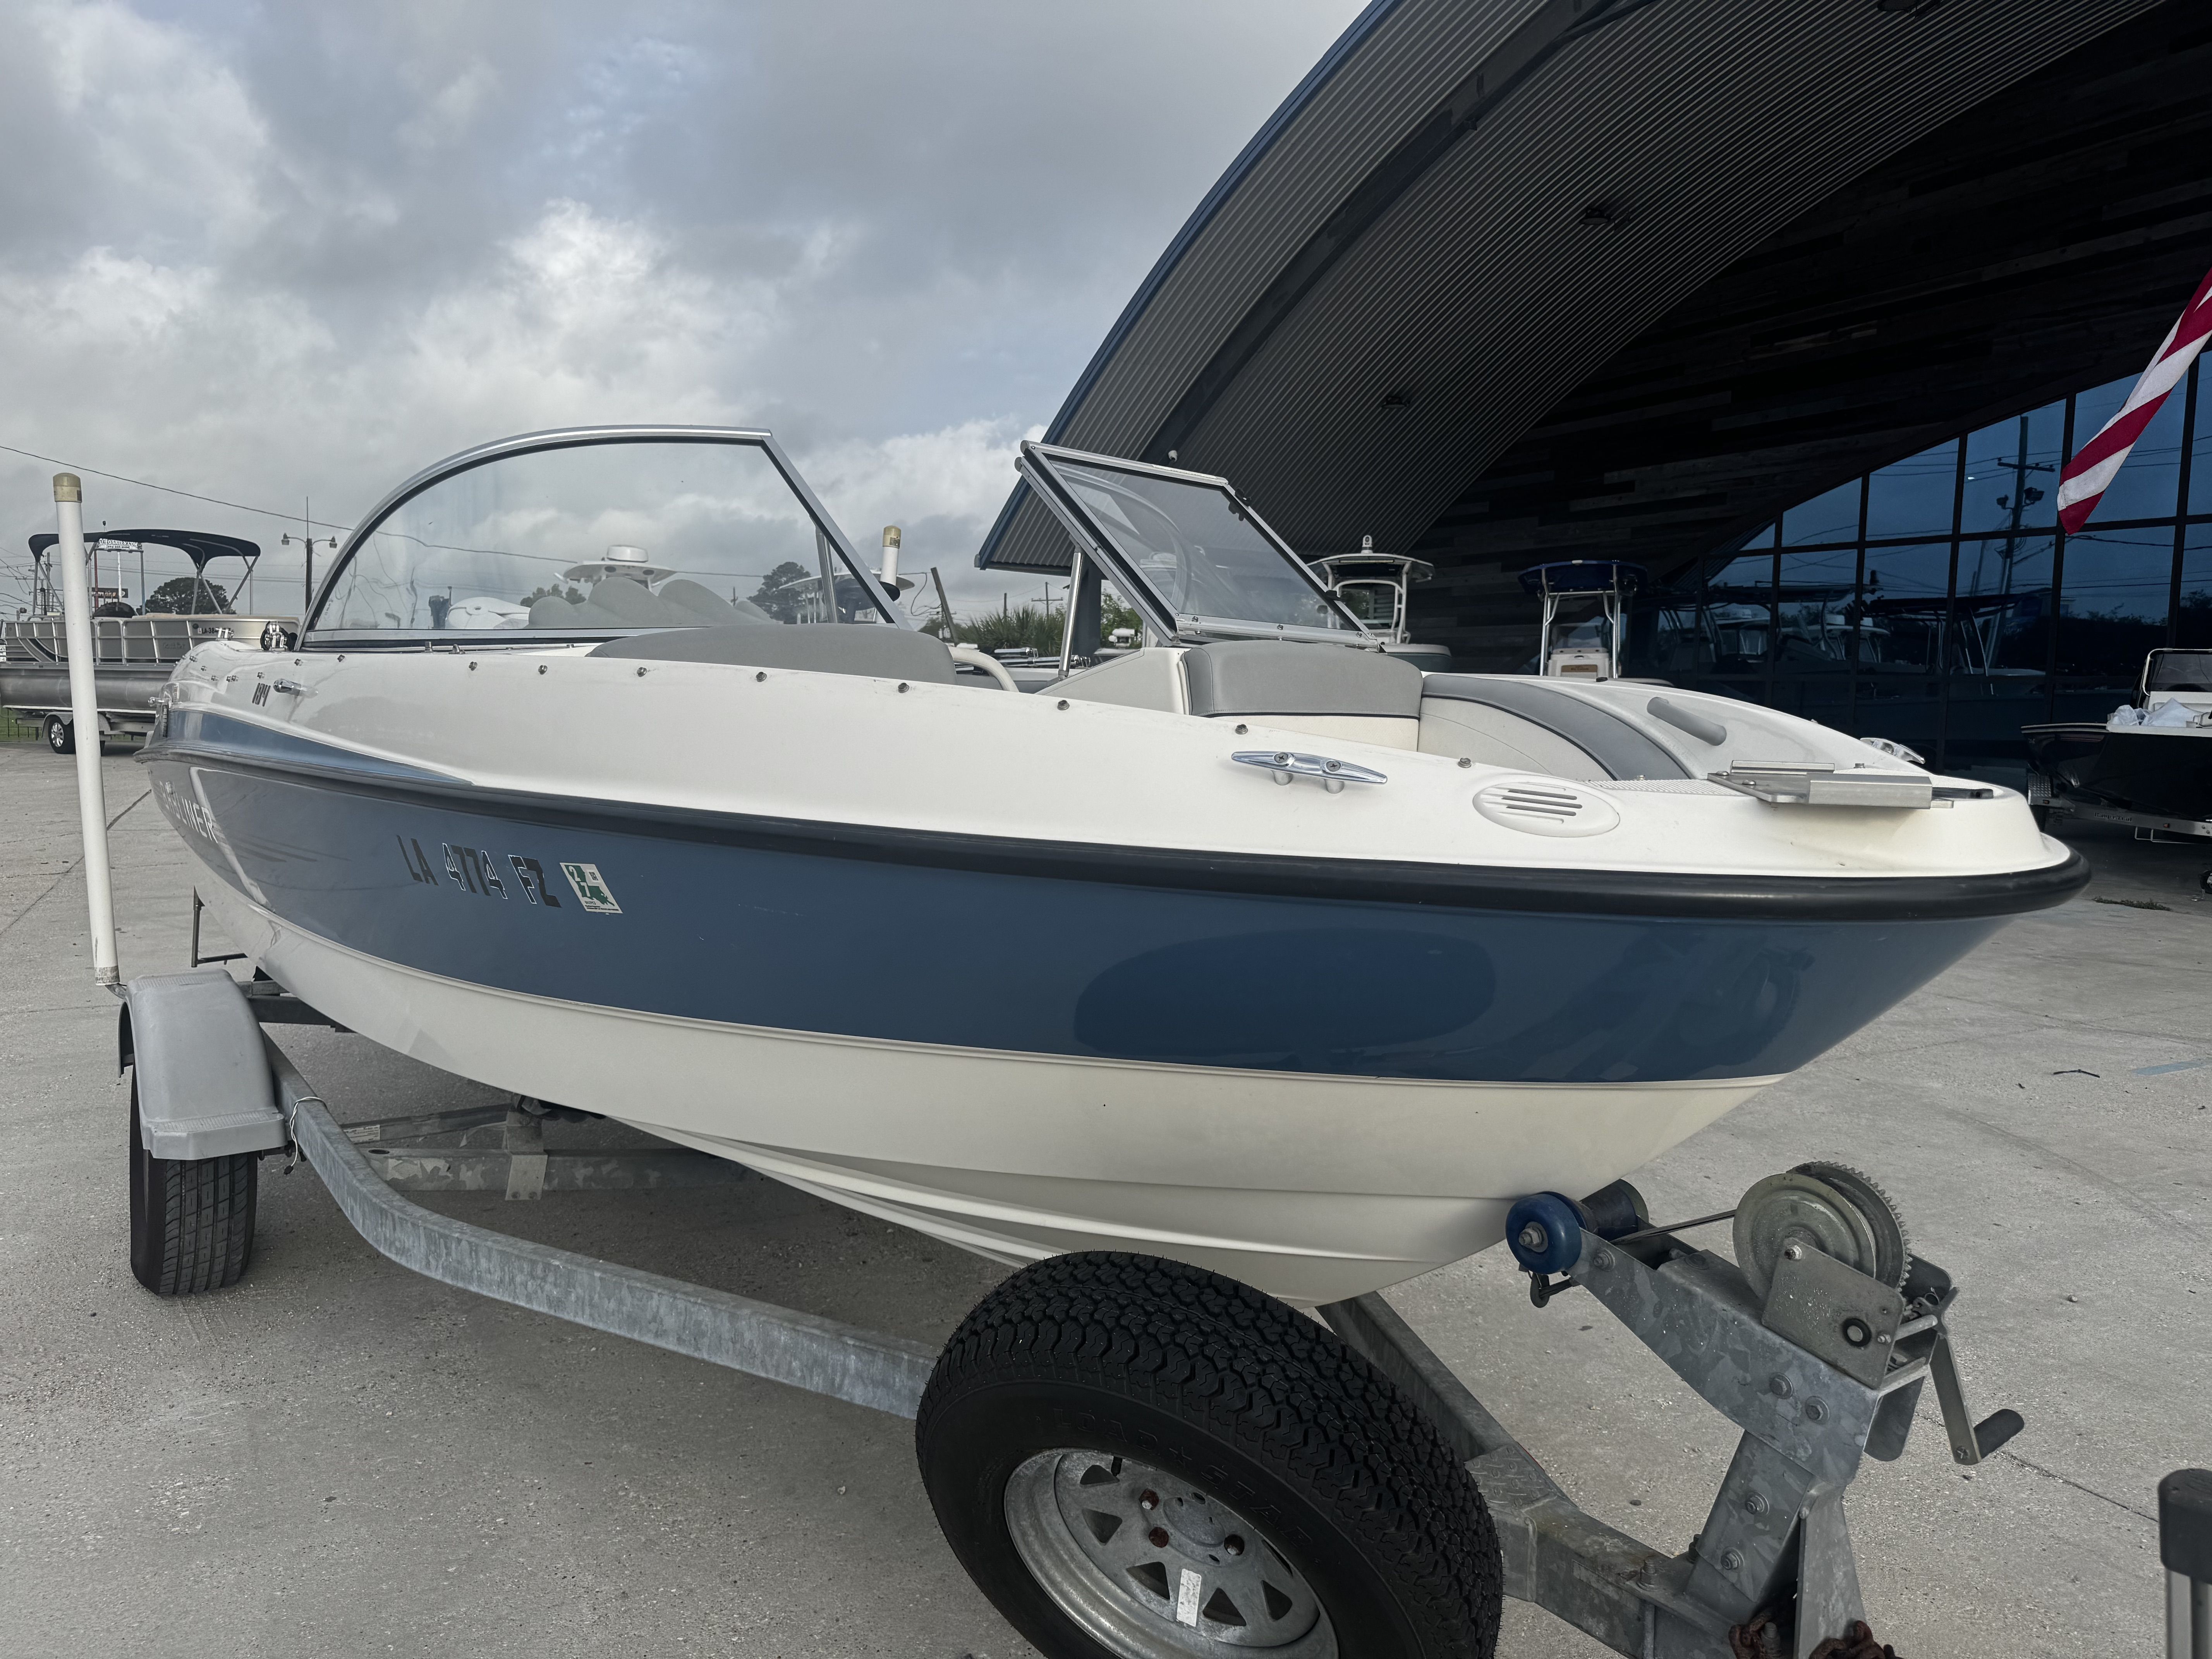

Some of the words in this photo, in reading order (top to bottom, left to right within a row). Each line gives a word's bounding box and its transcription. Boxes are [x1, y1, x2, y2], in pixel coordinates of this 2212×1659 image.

[397, 835, 439, 886] LA
[442, 843, 508, 899] 4774
[508, 854, 562, 908] FZ
[1053, 1408, 1158, 1452] LOAD
[1201, 1464, 1313, 1548] STAR
